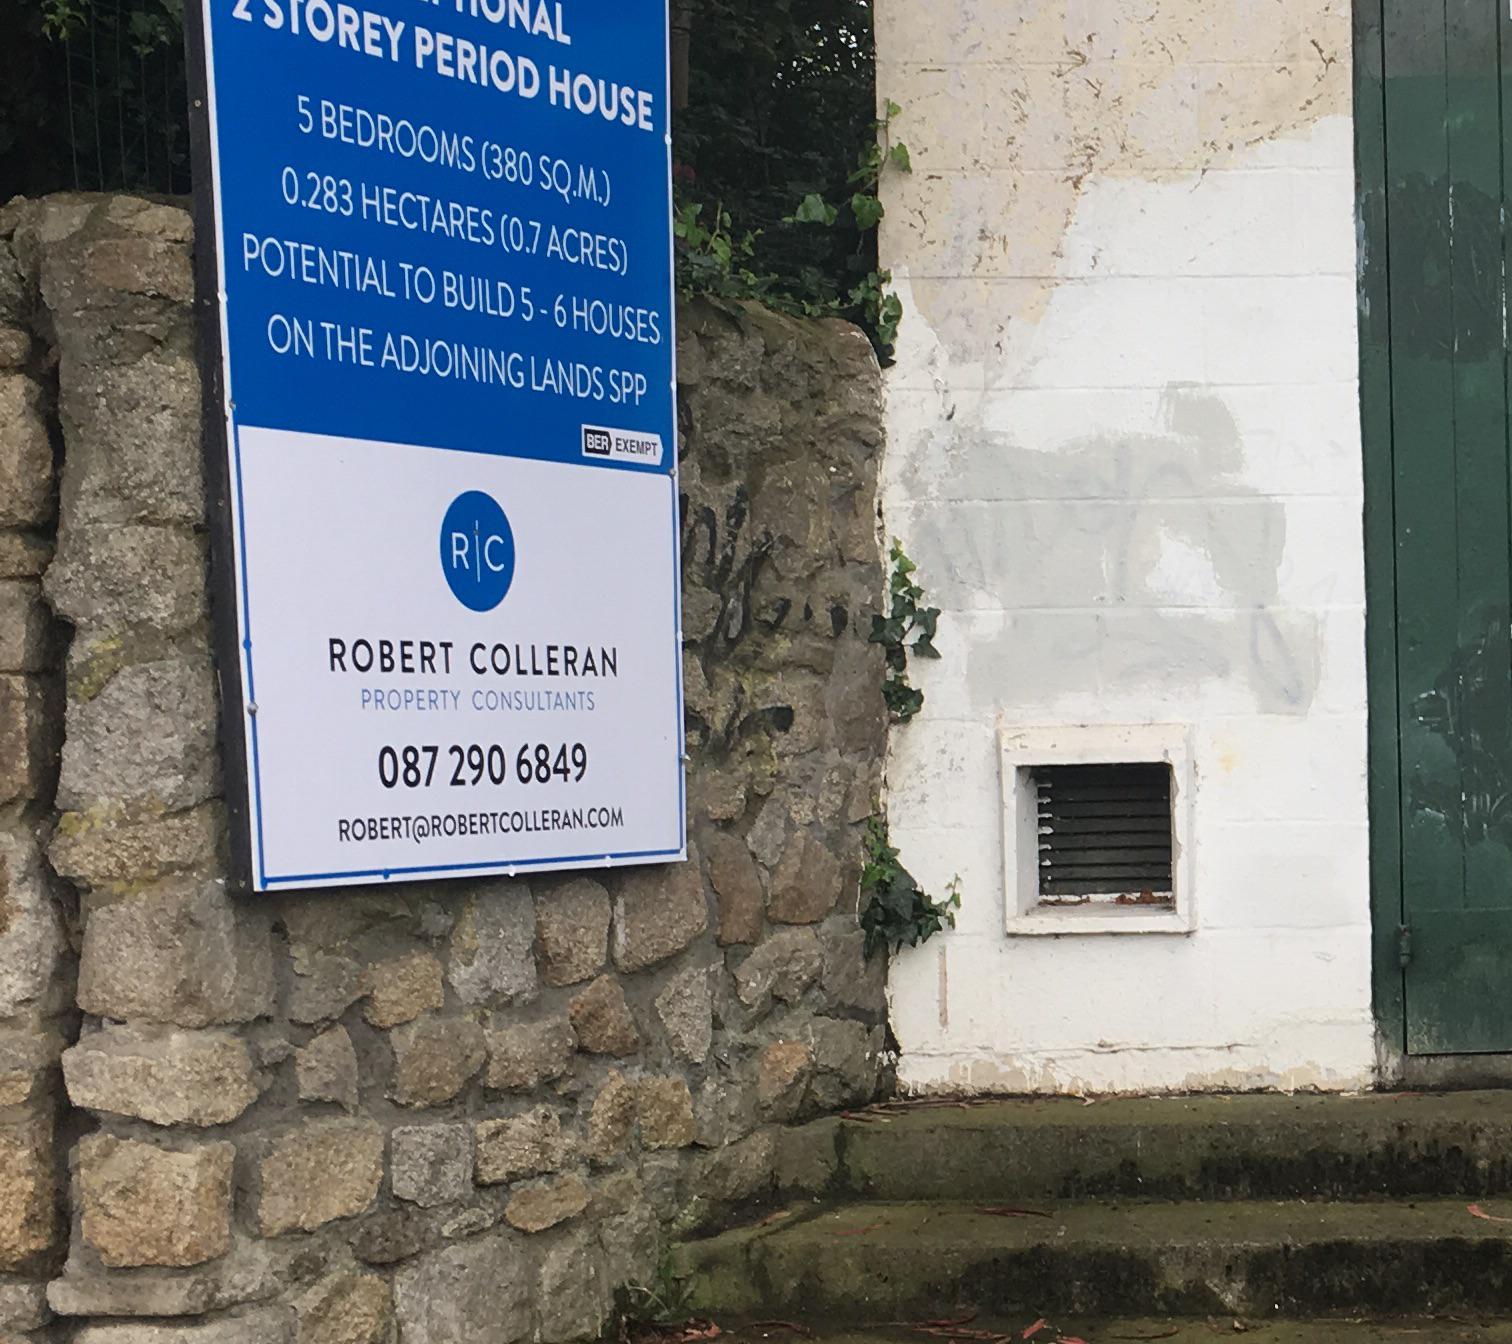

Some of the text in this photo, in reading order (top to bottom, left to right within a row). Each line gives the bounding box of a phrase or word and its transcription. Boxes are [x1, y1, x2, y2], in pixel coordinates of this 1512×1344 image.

[415, 27, 539, 97] PERIOD
[550, 66, 653, 131] HOUSE
[299, 96, 609, 206] 5 BEDROOMS (380 SQ.M.)
[283, 167, 627, 275] 0.283 HECTARES (0.7 ACRES)
[244, 233, 395, 296] POTENTIAL
[400, 263, 435, 302] TO
[444, 272, 514, 316] BUILD
[522, 288, 533, 320] 5
[555, 295, 566, 327] 6
[573, 297, 660, 344] HOUSES
[268, 315, 646, 404] ON THE ADJOINING LANDS SPP
[587, 435, 657, 456] BER EXEMPT
[329, 638, 616, 676] ROBERT COLLERAN
[362, 689, 594, 710] PROPERTY CONSULTANTS
[379, 743, 586, 788] 087 290 6849
[339, 808, 623, 843] ROBERT@ROBERTCOLLERAN.COM
